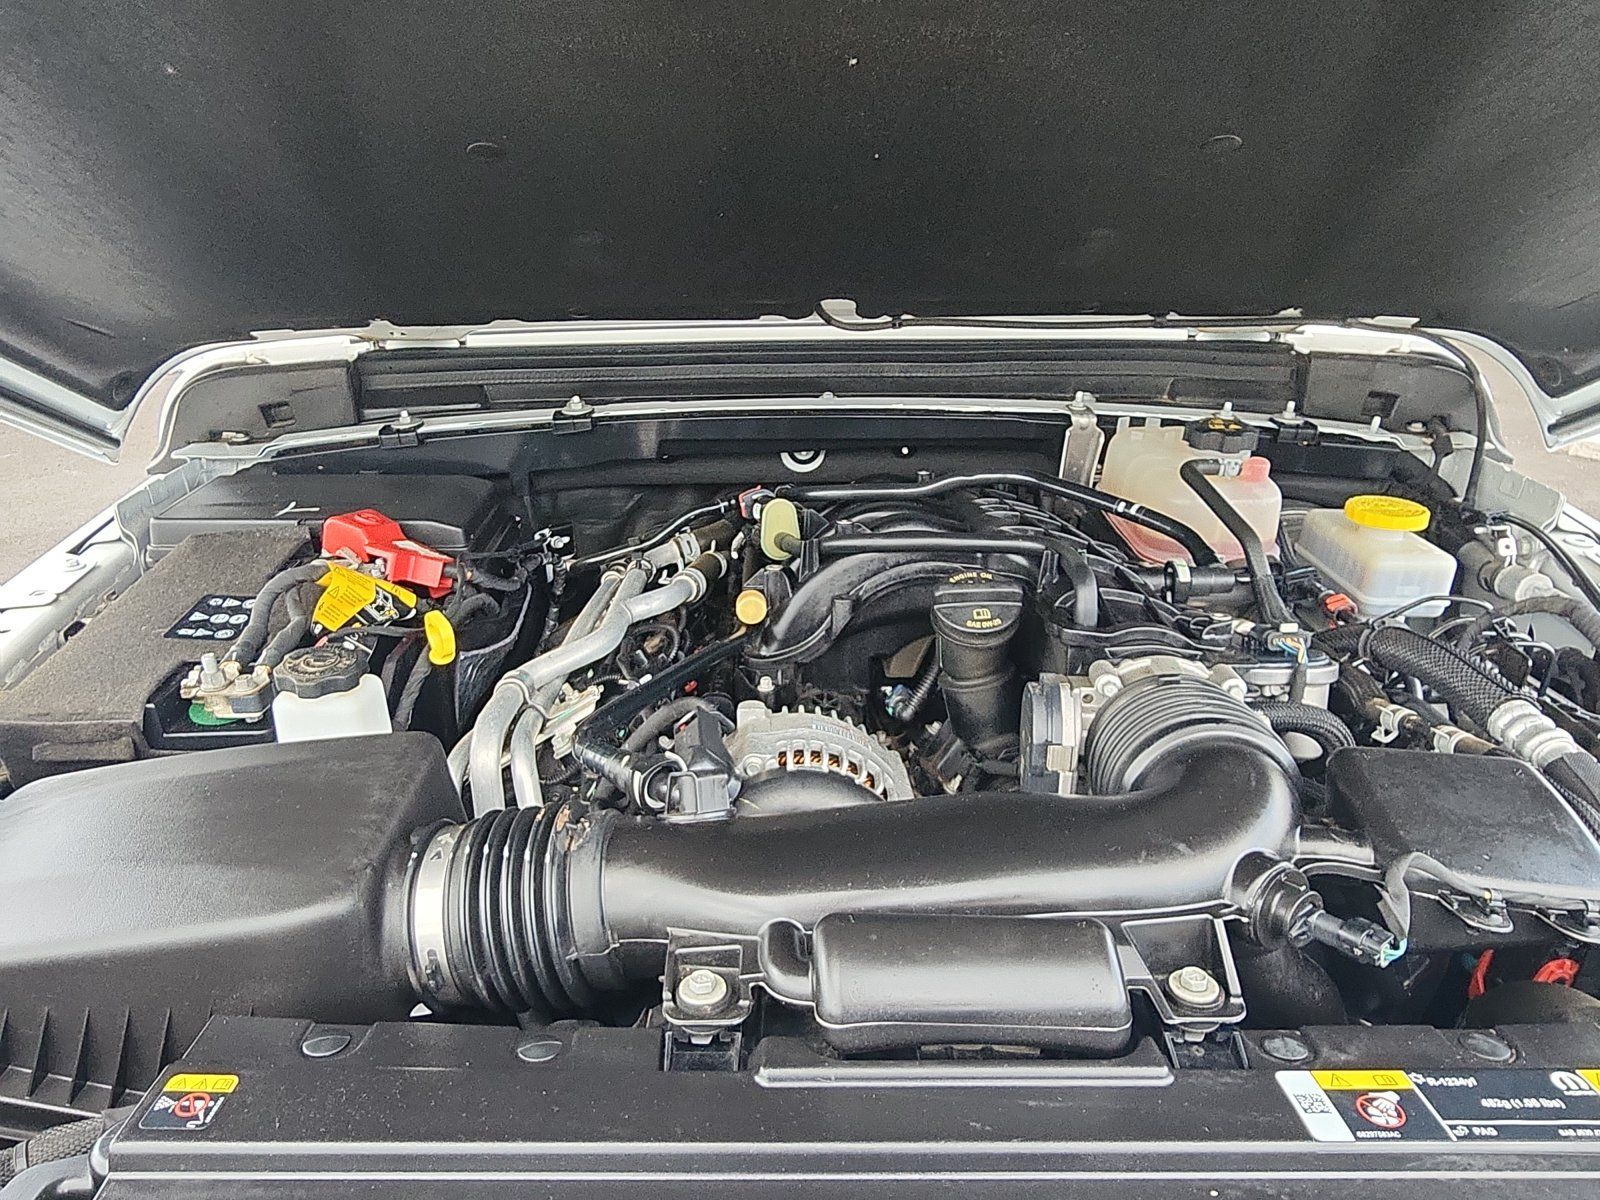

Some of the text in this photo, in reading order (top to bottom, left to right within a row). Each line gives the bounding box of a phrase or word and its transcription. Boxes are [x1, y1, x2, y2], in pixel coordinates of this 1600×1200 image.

[949, 572, 993, 583] ENGINE OIL
[966, 620, 981, 628] SAE
[1472, 1126, 1498, 1136] PAG
